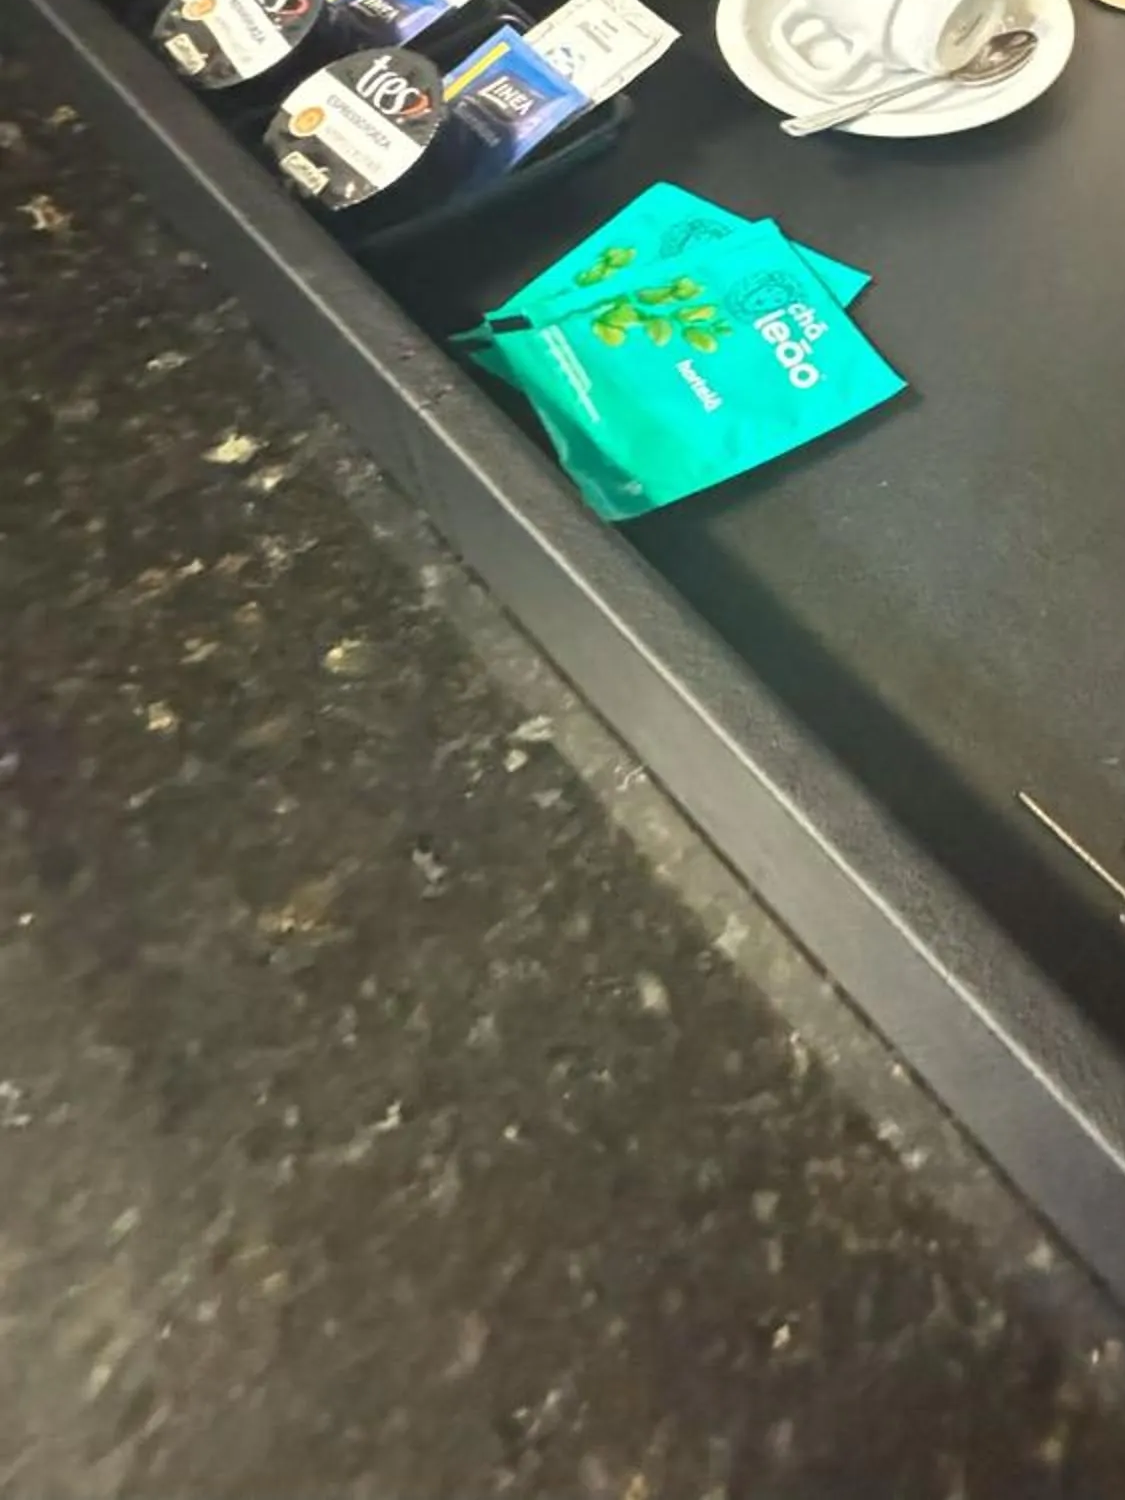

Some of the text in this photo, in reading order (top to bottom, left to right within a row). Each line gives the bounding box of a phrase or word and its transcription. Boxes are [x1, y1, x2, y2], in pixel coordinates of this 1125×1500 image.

[356, 55, 421, 115] tres
[477, 76, 535, 116] LINEA
[753, 308, 820, 389] leão
